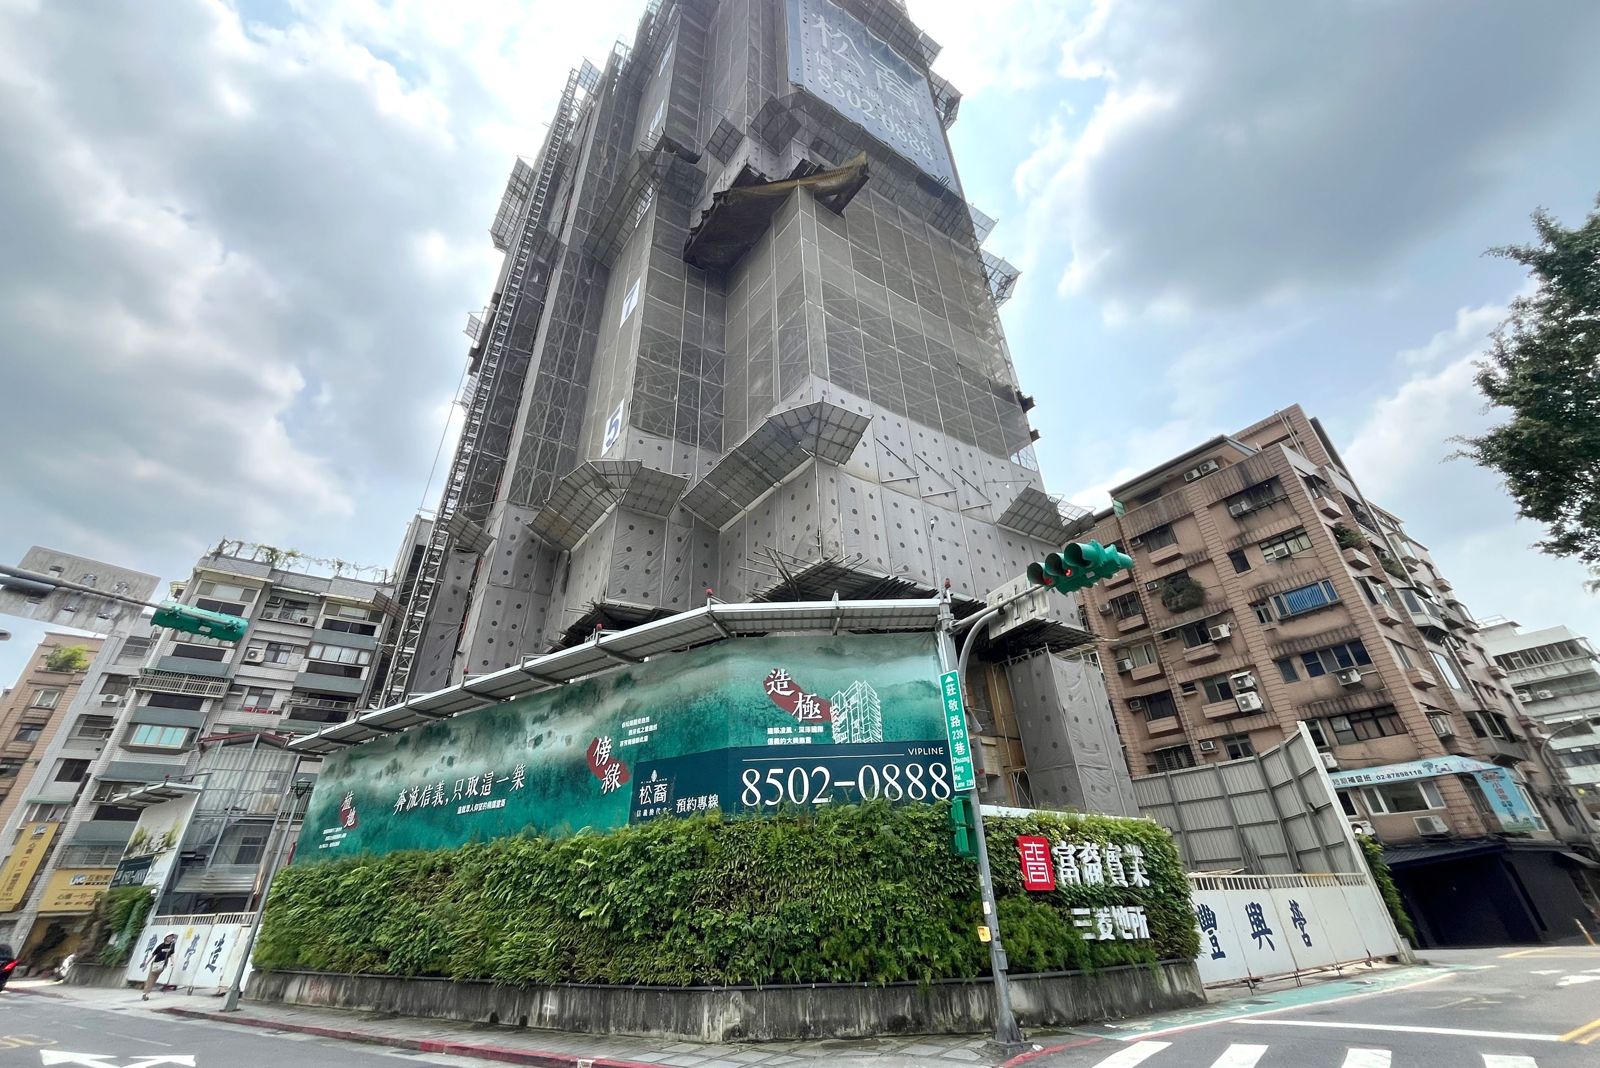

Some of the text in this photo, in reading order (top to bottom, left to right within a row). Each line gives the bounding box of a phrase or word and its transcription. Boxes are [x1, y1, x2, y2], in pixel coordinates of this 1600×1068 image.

[606, 406, 619, 448] 5
[766, 668, 823, 723] 造極
[945, 683, 967, 756] 莊敬路239巷
[907, 747, 944, 756] VIPLINE
[639, 783, 668, 805] 松裔
[676, 794, 719, 814] 預約專線
[741, 763, 951, 807] 8502-0888
[1071, 905, 1151, 941] 三菱地所
